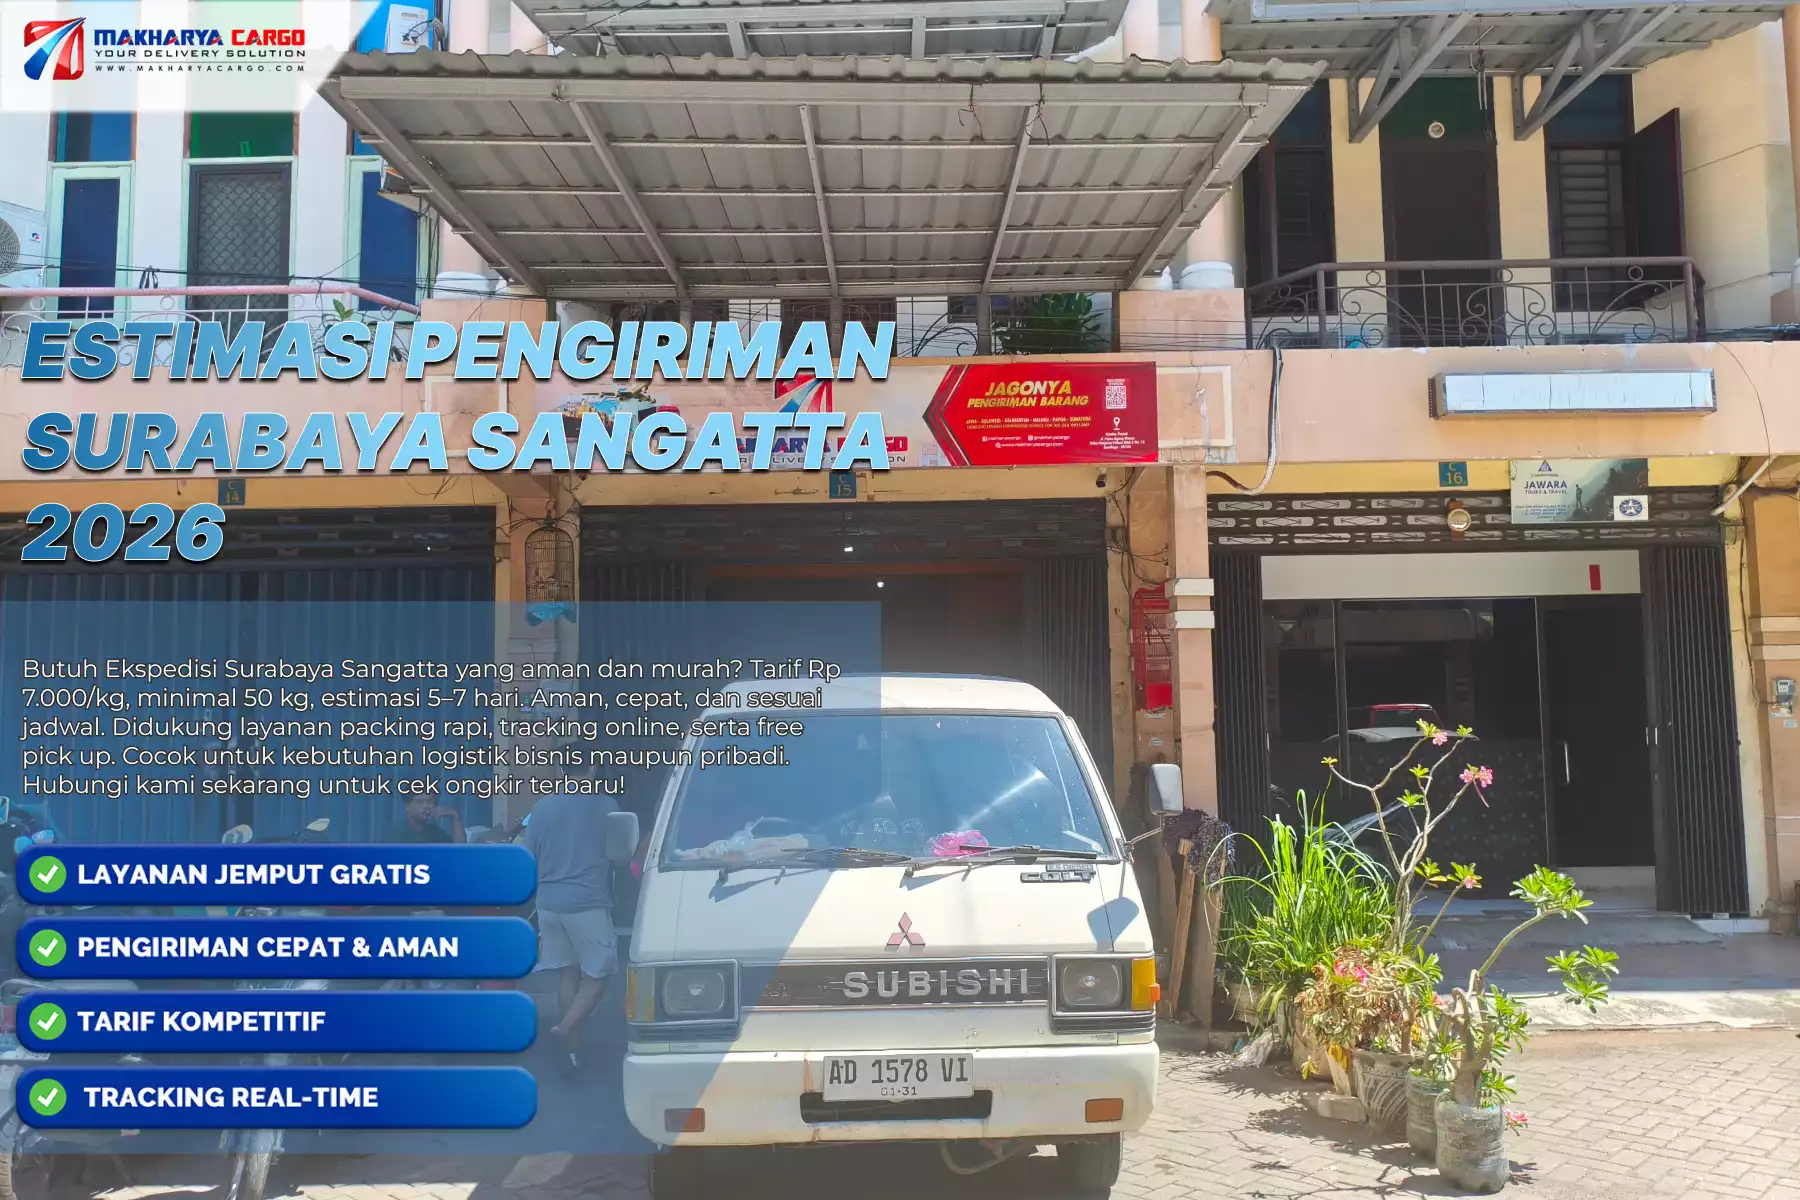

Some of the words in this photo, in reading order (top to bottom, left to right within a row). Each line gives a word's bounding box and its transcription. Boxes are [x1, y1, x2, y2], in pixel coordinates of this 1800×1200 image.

[985, 380, 1072, 396] JAGONYA
[967, 397, 1036, 408] PENGIRIMAN
[1040, 396, 1088, 406] BARANG
[1445, 472, 1463, 484] 16
[837, 485, 851, 496] 15
[1524, 480, 1568, 489] JAWARA
[226, 491, 240, 503] 14
[843, 968, 1028, 998] SUBISHI
[829, 1060, 857, 1084] AD
[871, 1058, 928, 1084] 1578
[941, 1058, 968, 1082] VI
